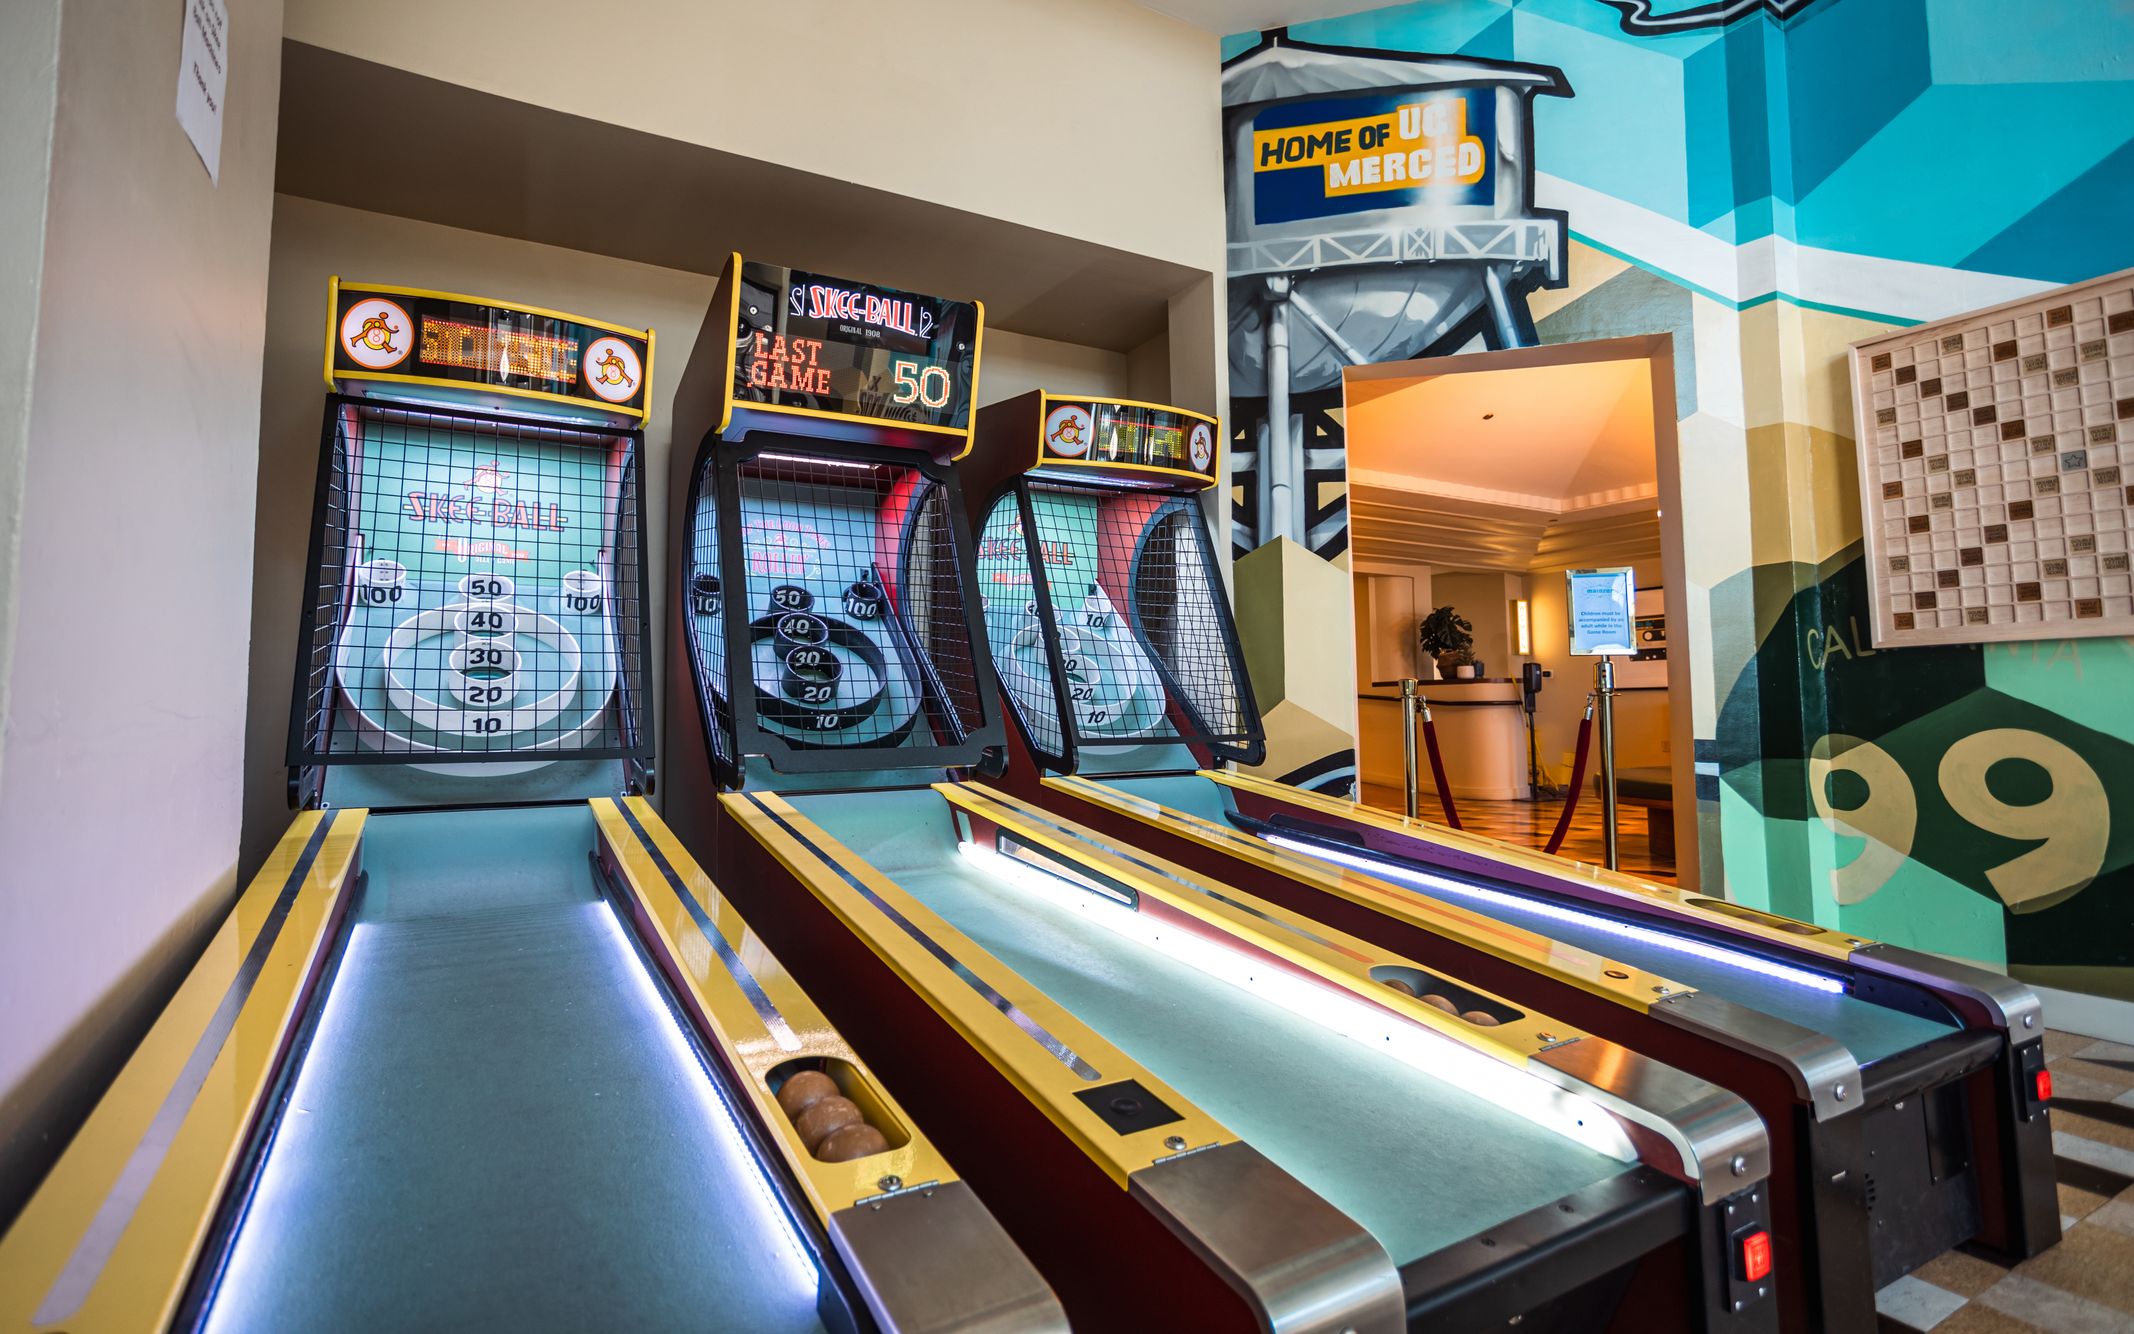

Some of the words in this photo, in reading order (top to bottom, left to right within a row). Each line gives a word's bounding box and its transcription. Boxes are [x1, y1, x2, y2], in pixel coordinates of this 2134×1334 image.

[1260, 129, 1352, 167] HOME
[1358, 123, 1390, 150] OF
[1329, 142, 1482, 188] MERCED
[840, 324, 862, 336] ORIGINAL
[865, 328, 881, 338] 1908
[754, 332, 822, 366] LAST
[751, 360, 831, 395] GAME
[894, 360, 950, 408] 50
[361, 584, 402, 604] 100
[471, 580, 501, 597] 50
[566, 593, 600, 612] 100
[699, 596, 721, 612] 10
[773, 590, 800, 606] 50
[848, 599, 877, 618] 100
[471, 612, 502, 629] 40
[784, 619, 810, 635] 40
[469, 648, 502, 665] 30
[794, 651, 820, 667] 30
[469, 686, 502, 703] 20
[804, 686, 832, 701] 20
[1072, 688, 1093, 701] 20
[816, 713, 838, 728] 10
[1088, 711, 1105, 723] 10
[473, 718, 501, 734] 10
